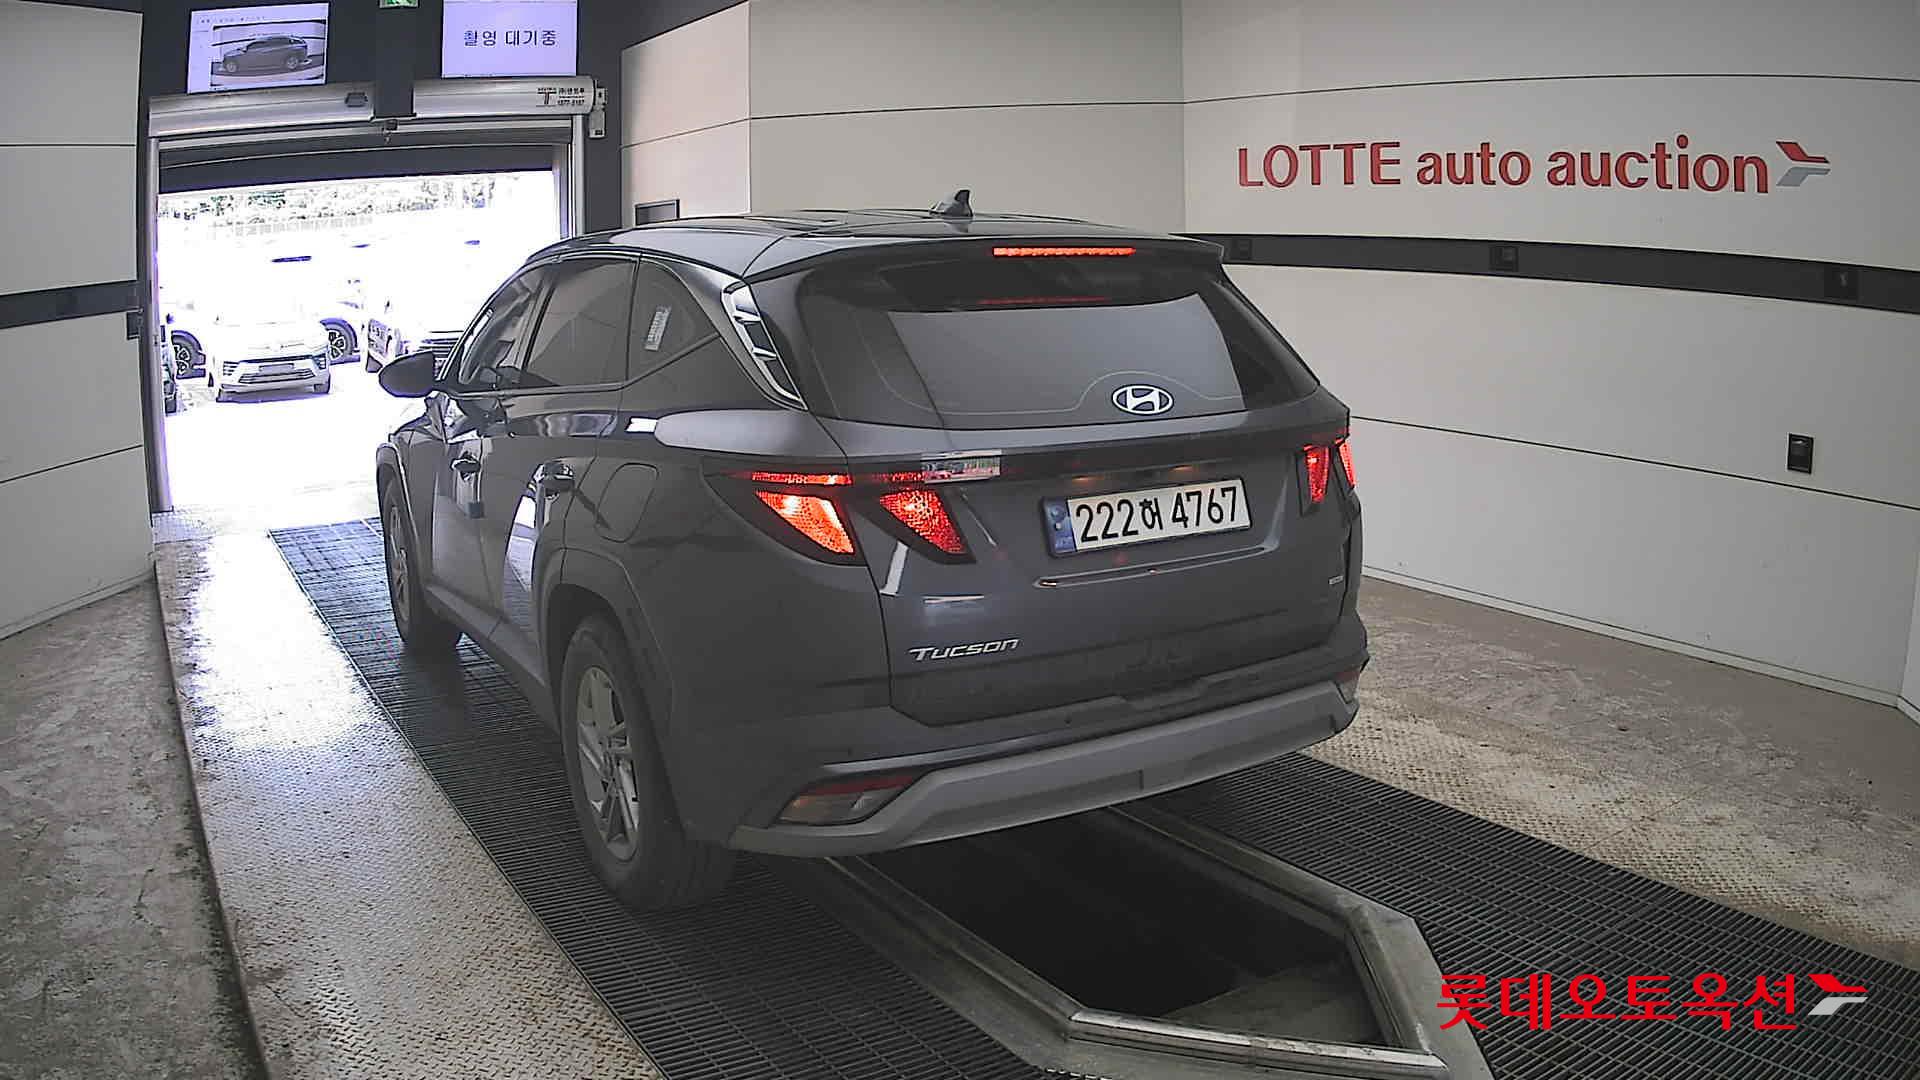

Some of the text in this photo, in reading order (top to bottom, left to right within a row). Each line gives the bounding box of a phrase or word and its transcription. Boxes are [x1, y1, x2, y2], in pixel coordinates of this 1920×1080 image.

[505, 29, 556, 47] 대기중
[1238, 134, 1769, 194] LOTTE auto auction
[1075, 486, 1237, 543] 222허 4767
